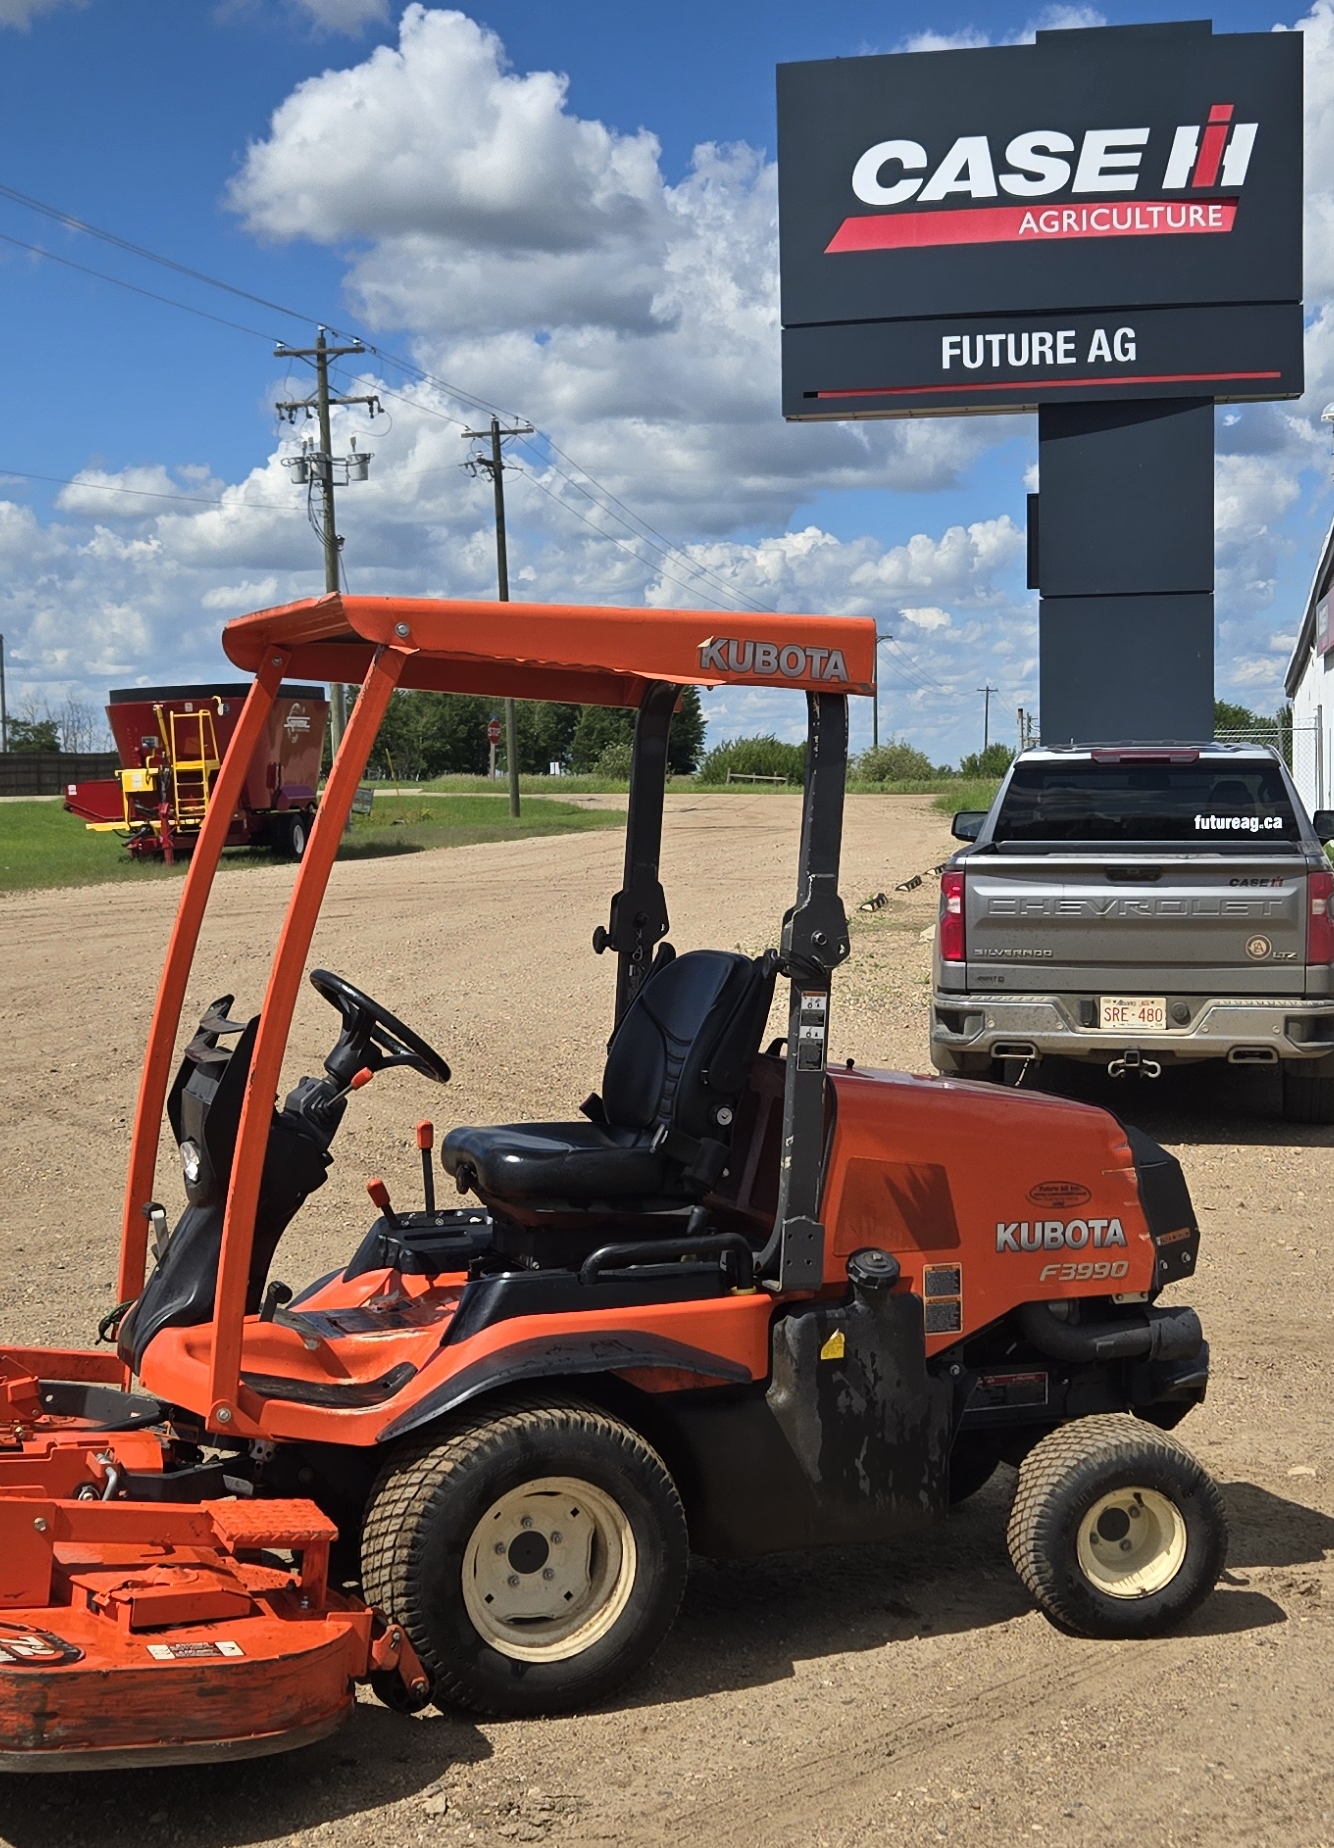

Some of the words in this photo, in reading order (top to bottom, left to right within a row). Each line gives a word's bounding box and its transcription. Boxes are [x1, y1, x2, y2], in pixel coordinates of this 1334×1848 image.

[851, 126, 1151, 206] CASE
[1018, 205, 1223, 235] AGRICULTURE
[941, 329, 1077, 370] FUTURE
[1087, 327, 1137, 364] AG
[699, 637, 850, 683] KUBOTA
[1194, 814, 1283, 832] futureag.ca
[1229, 878, 1270, 888] CASE
[987, 899, 1283, 916] CHEVROLET
[973, 948, 1053, 958] SILVERADO
[1272, 951, 1298, 960] LTZ
[996, 1217, 1128, 1253] KUBOTA
[1038, 1261, 1129, 1282] F3990
